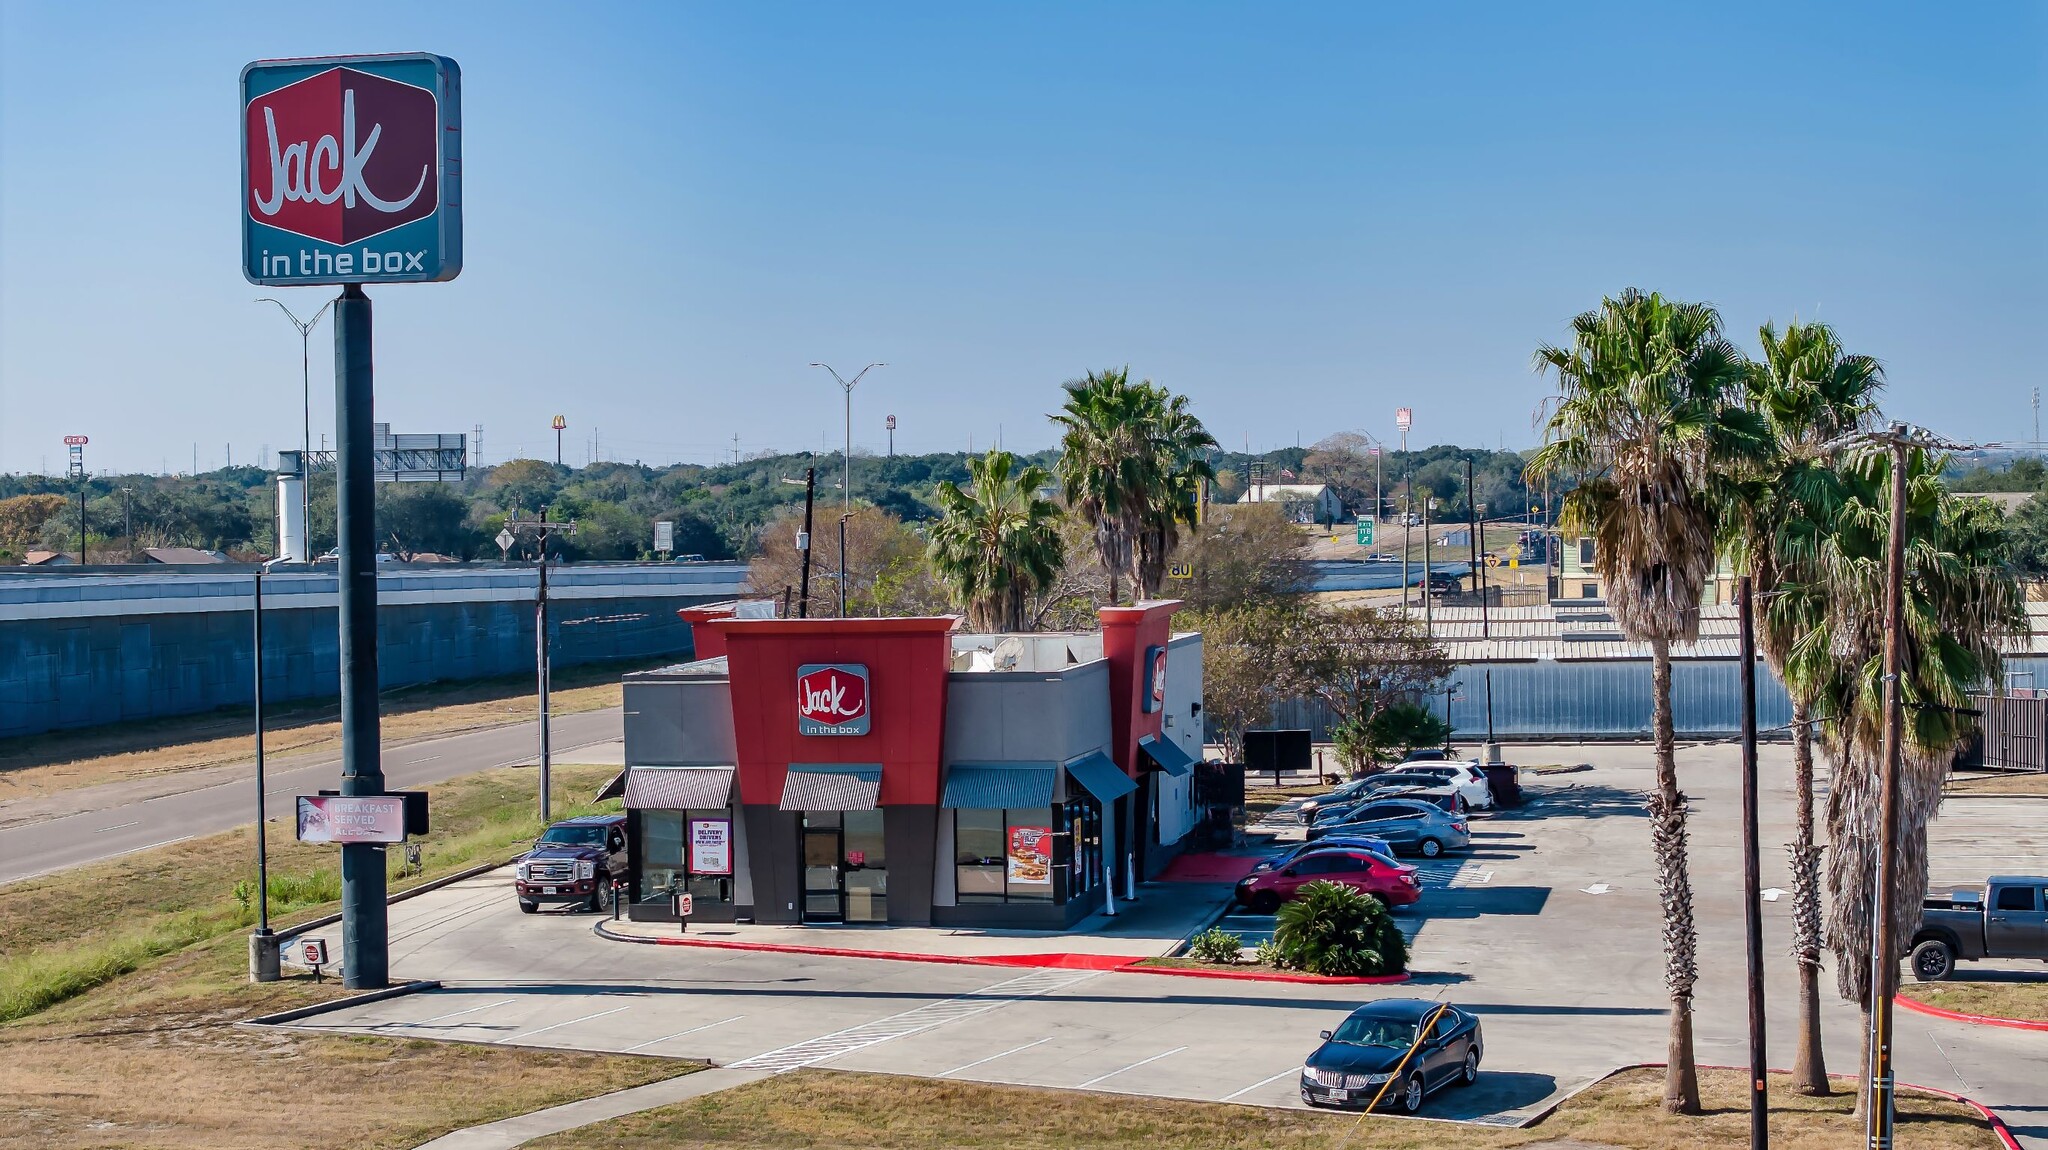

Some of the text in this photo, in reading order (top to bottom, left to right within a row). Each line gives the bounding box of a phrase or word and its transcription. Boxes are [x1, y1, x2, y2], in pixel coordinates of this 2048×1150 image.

[253, 89, 428, 216] Jack
[262, 247, 424, 276] in the box
[801, 675, 863, 716] Jack
[806, 725, 860, 734] in the box
[334, 803, 395, 814] BREAKFAST
[334, 815, 376, 825] SERVED
[335, 827, 354, 836] ALL
